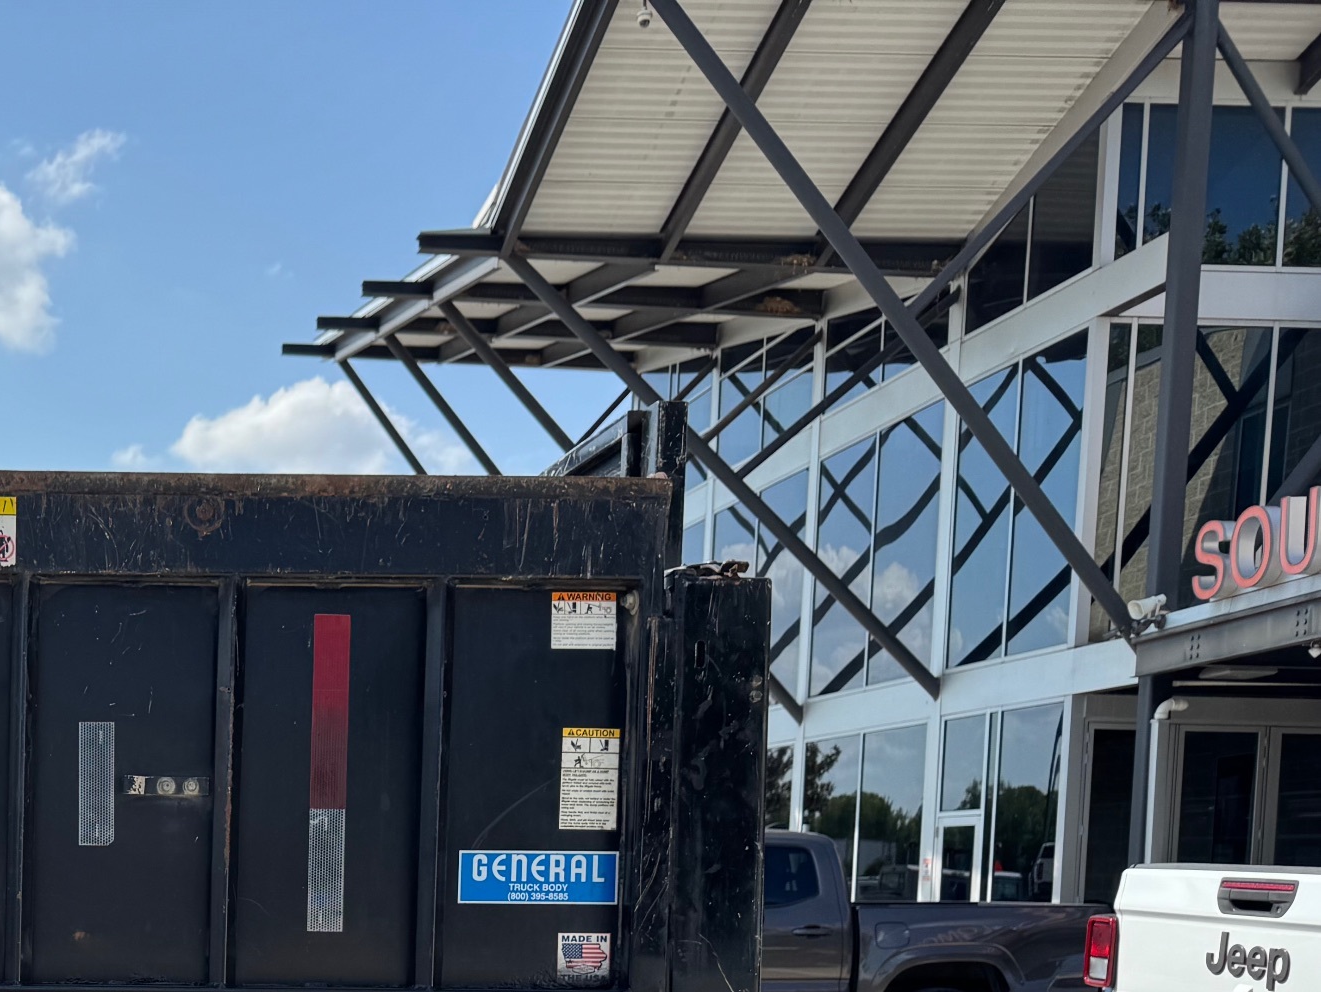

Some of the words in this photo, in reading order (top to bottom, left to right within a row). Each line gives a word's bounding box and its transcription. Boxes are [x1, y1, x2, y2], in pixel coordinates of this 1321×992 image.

[575, 728, 615, 737] CAUTION
[472, 853, 605, 883] GENERAL
[509, 883, 540, 891] TRUCK
[542, 883, 568, 892] BODY
[508, 892, 529, 901] (800)
[530, 892, 569, 901] 395-8585
[561, 935, 593, 943] MADE
[596, 935, 608, 943] IN
[1206, 931, 1291, 992] Jeep
[560, 974, 582, 982] THE
